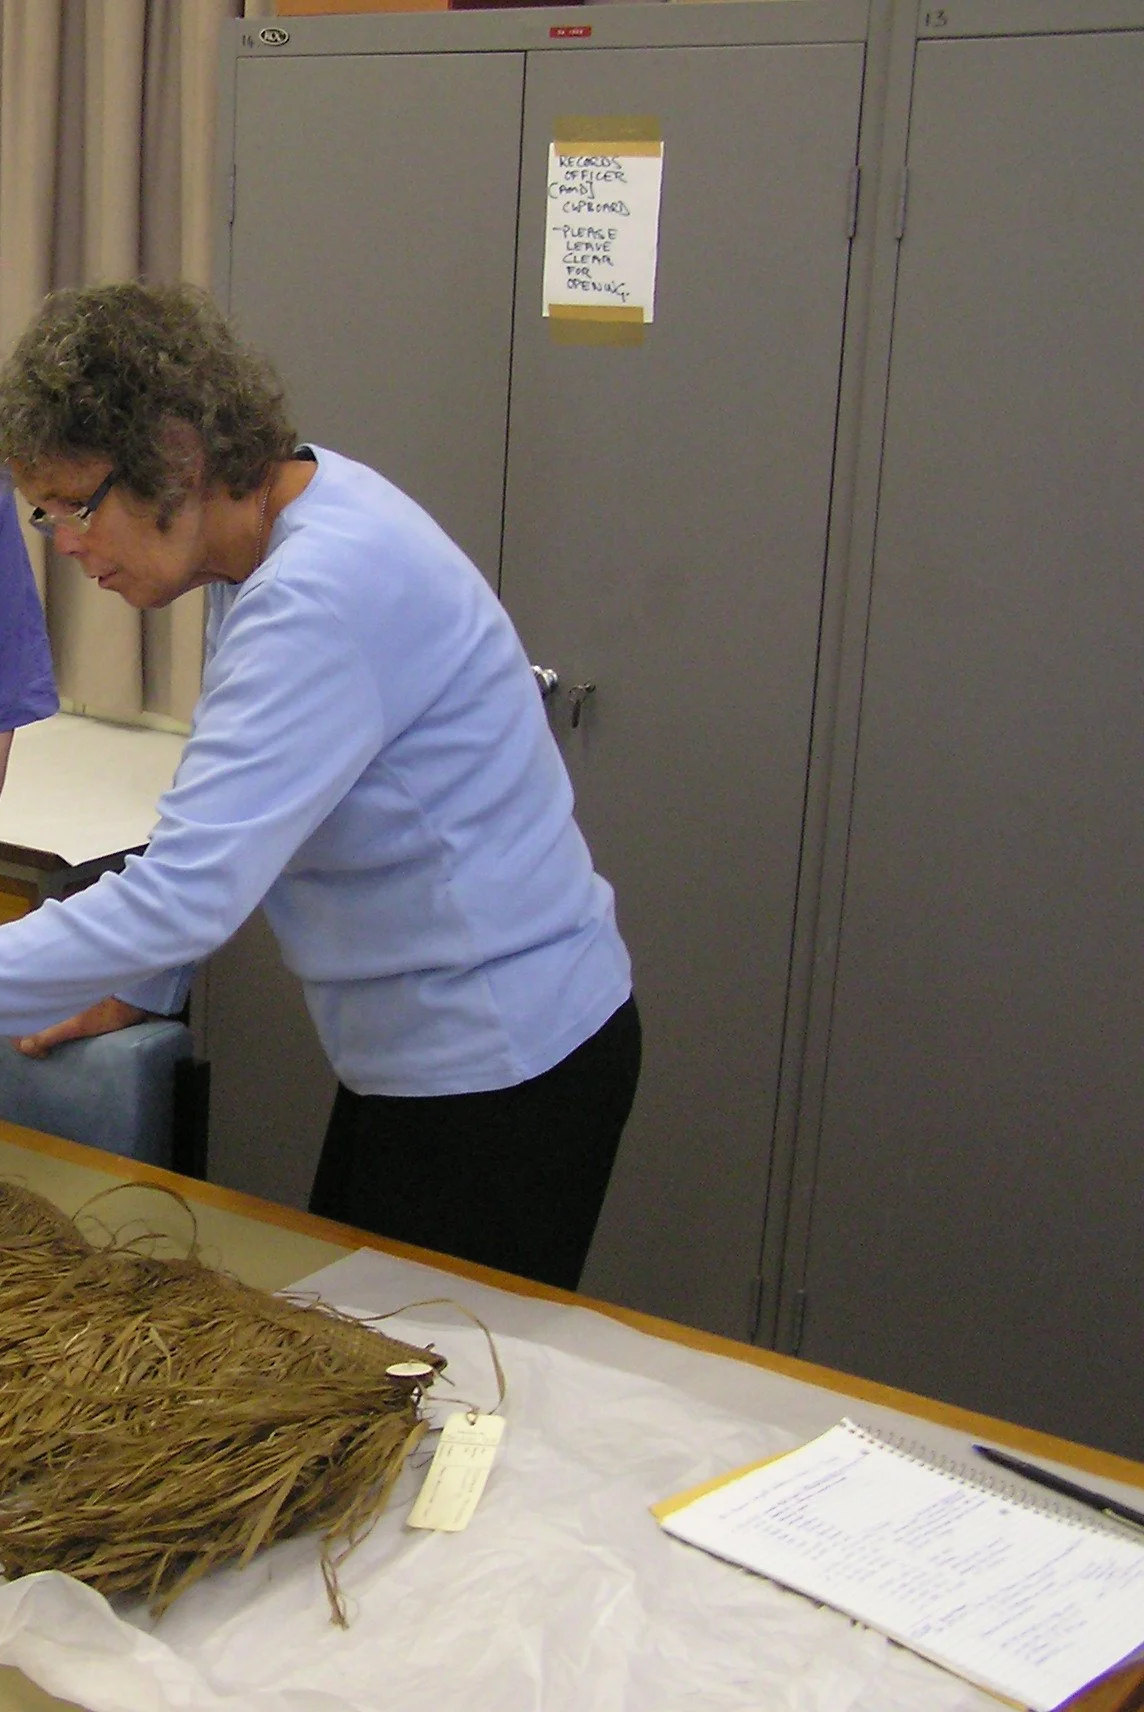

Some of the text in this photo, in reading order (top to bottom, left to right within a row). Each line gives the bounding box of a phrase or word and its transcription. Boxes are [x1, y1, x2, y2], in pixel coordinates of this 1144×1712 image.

[564, 169, 628, 183] OFFICER
[566, 240, 611, 252] LEAVE
[562, 252, 614, 267] CLEAR
[566, 265, 592, 279] FOR
